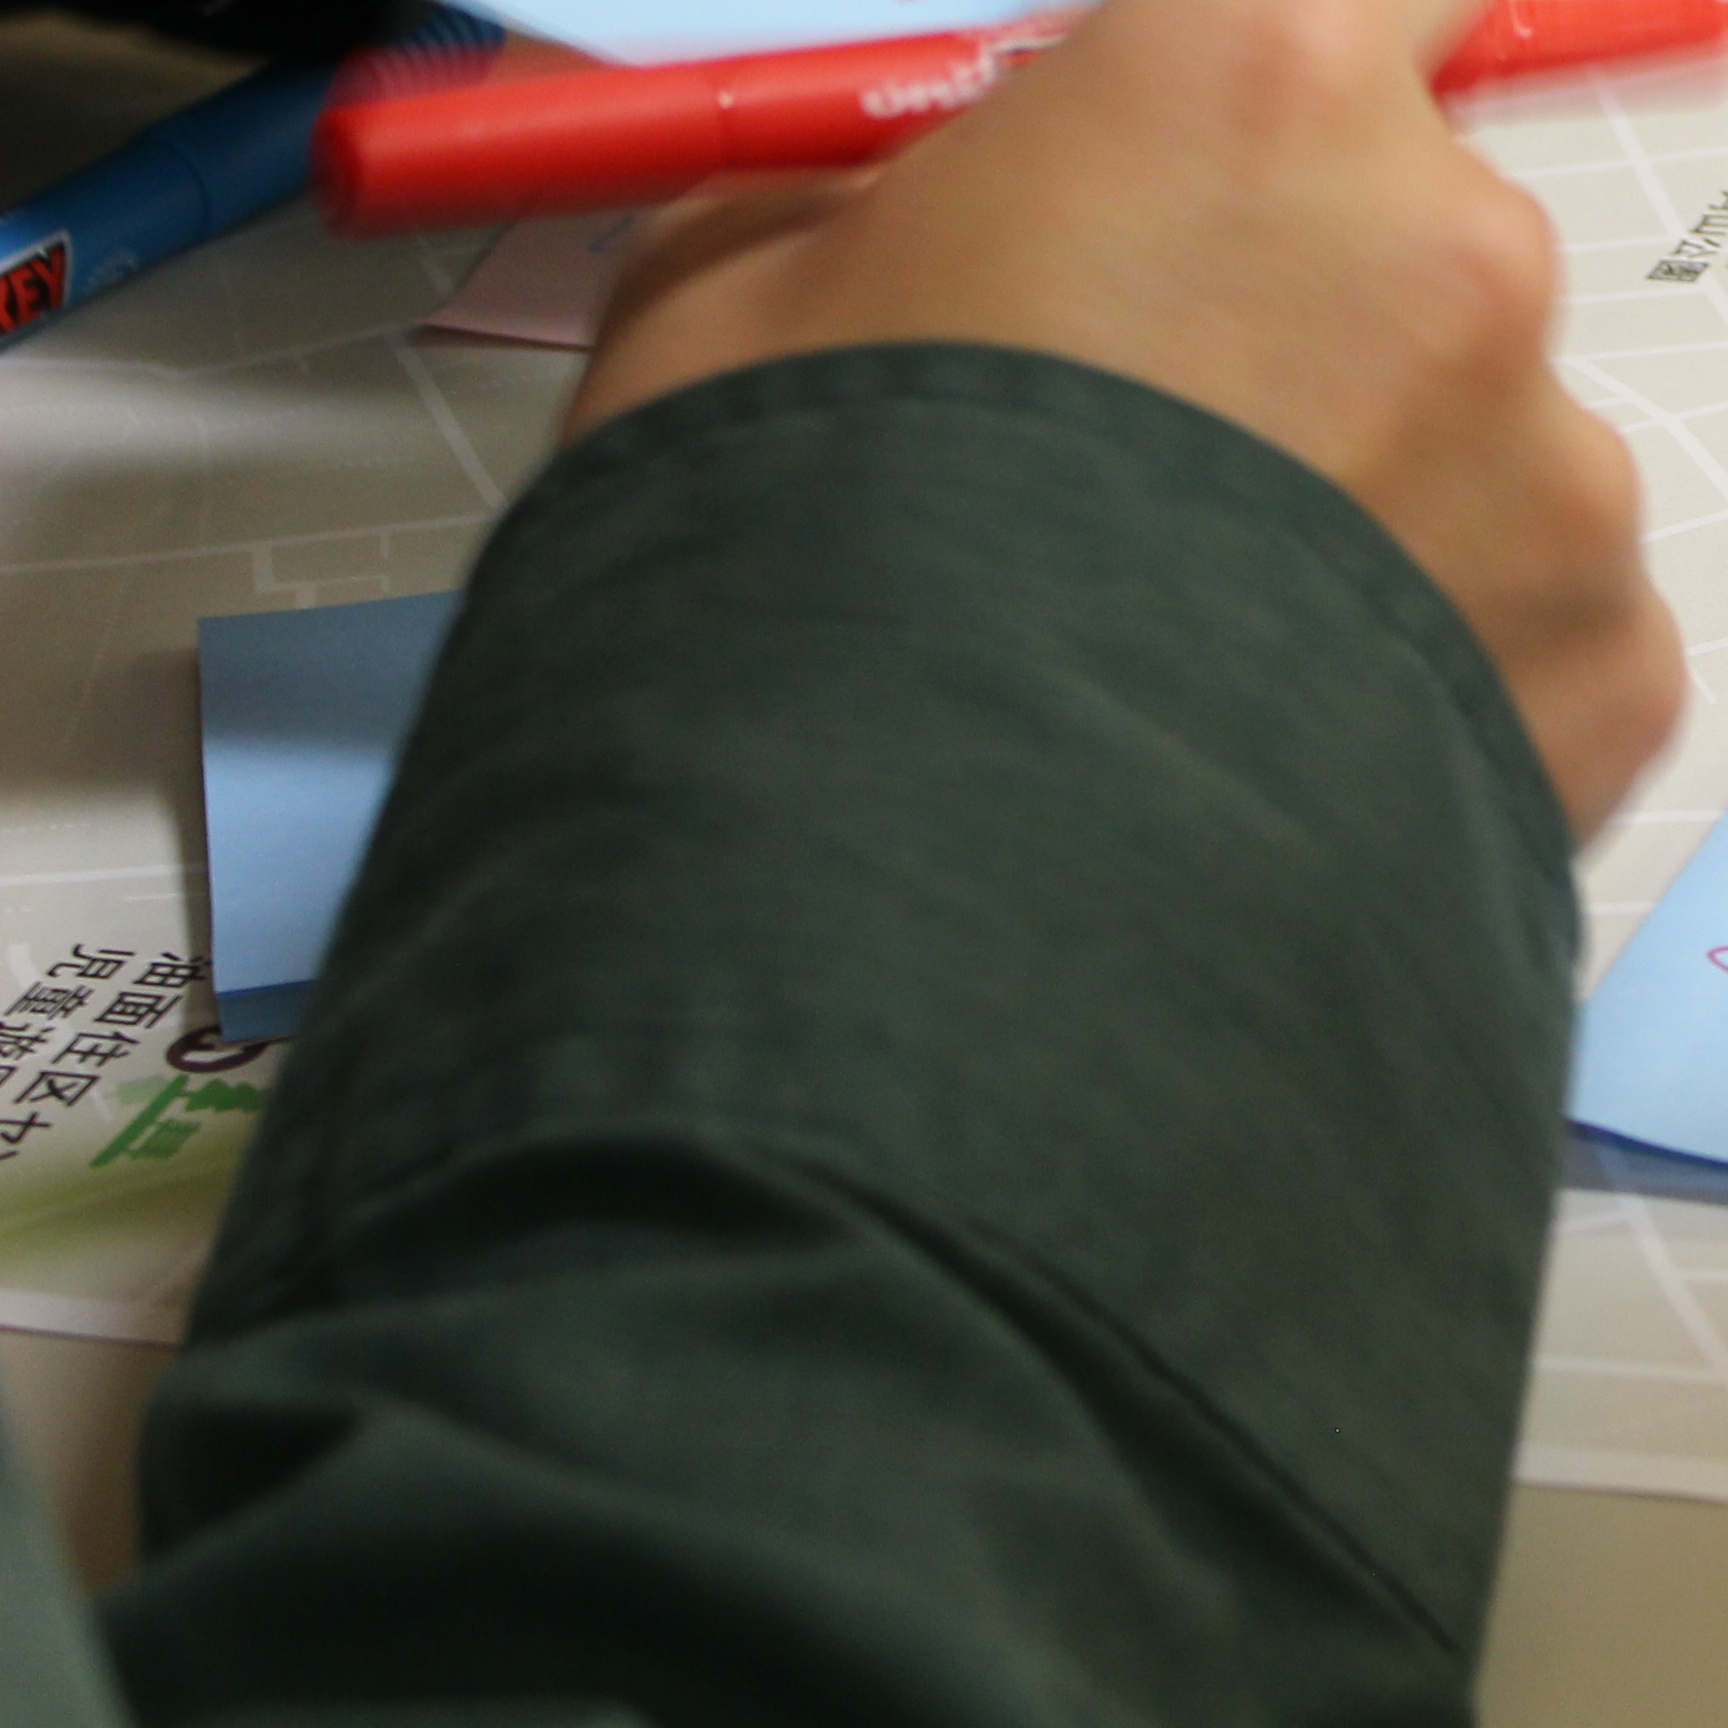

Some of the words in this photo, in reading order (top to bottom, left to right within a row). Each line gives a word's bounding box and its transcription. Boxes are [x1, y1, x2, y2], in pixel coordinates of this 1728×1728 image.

[0, 952, 212, 1161] 油面住区セ
